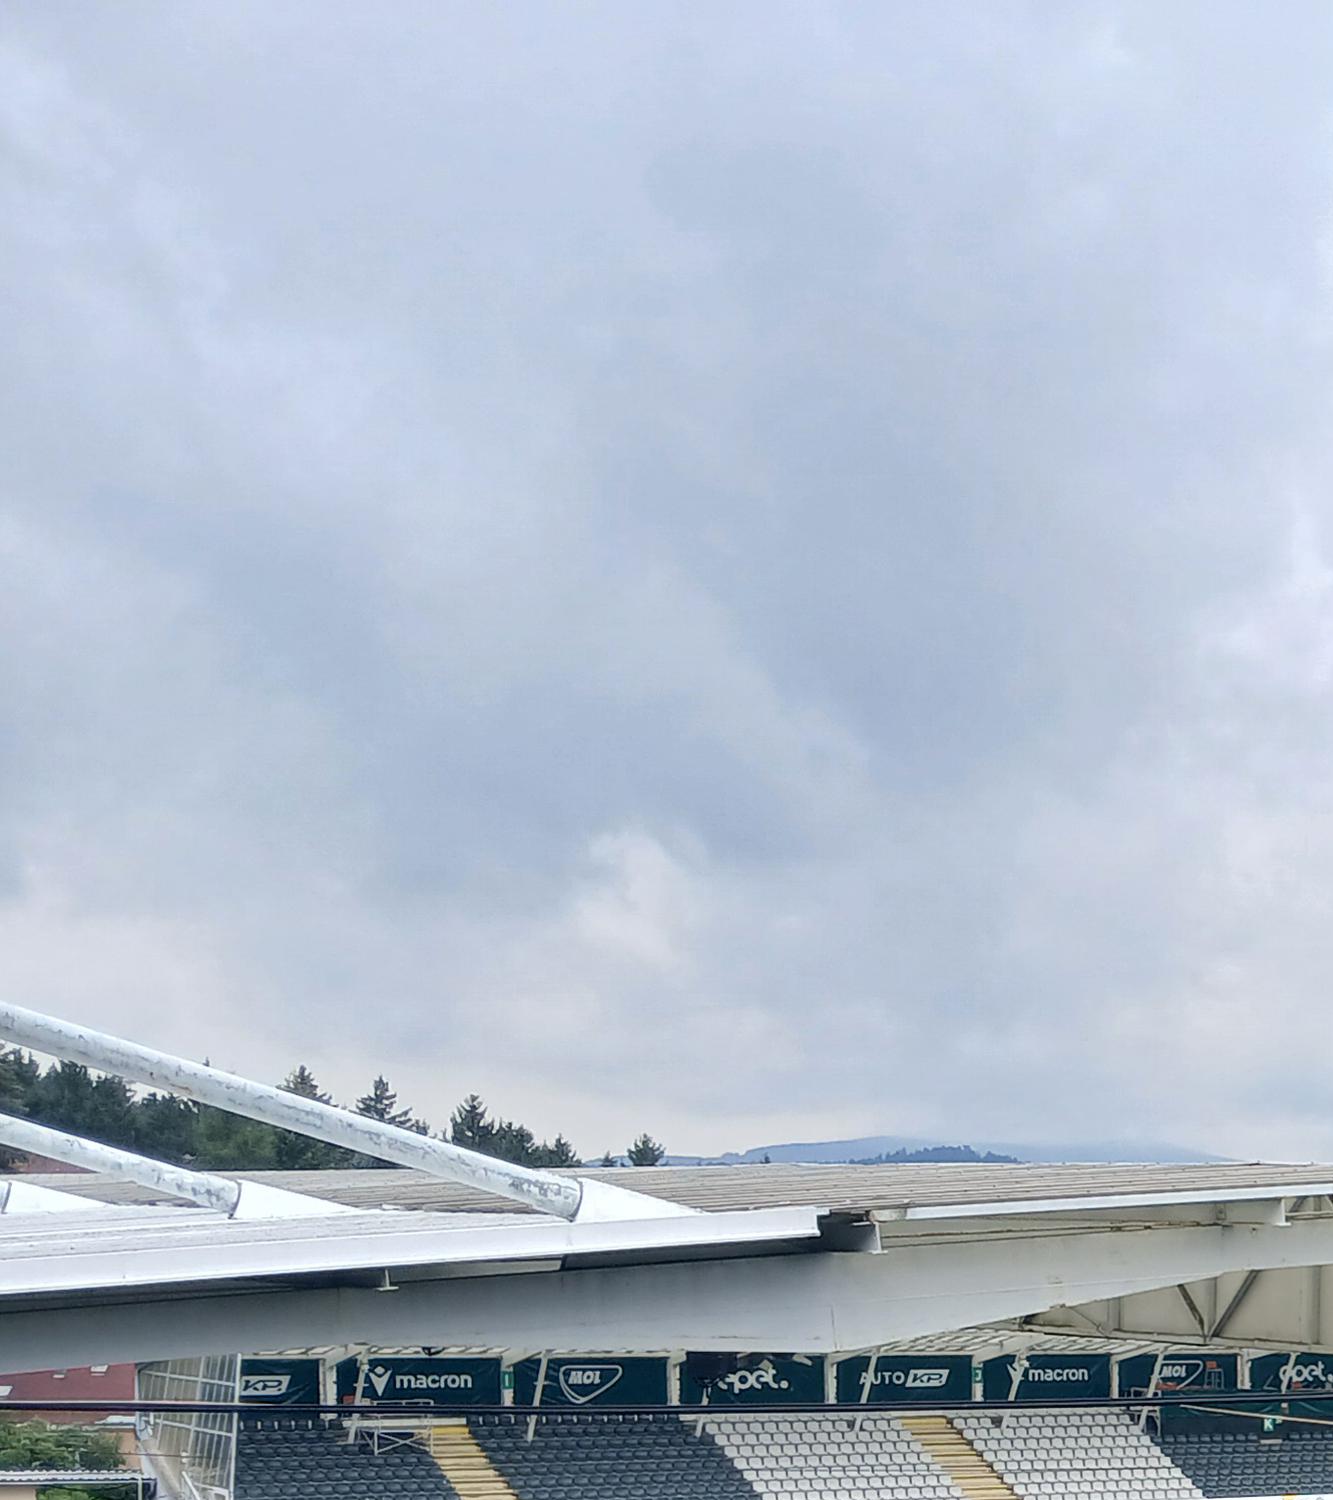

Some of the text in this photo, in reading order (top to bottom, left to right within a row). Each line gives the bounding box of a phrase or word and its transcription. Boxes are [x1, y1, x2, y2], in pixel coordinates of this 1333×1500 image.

[395, 1374, 473, 1389] macron
[568, 1370, 601, 1385] MOL
[859, 1371, 906, 1385] AUTO
[1028, 1368, 1089, 1382] macron
